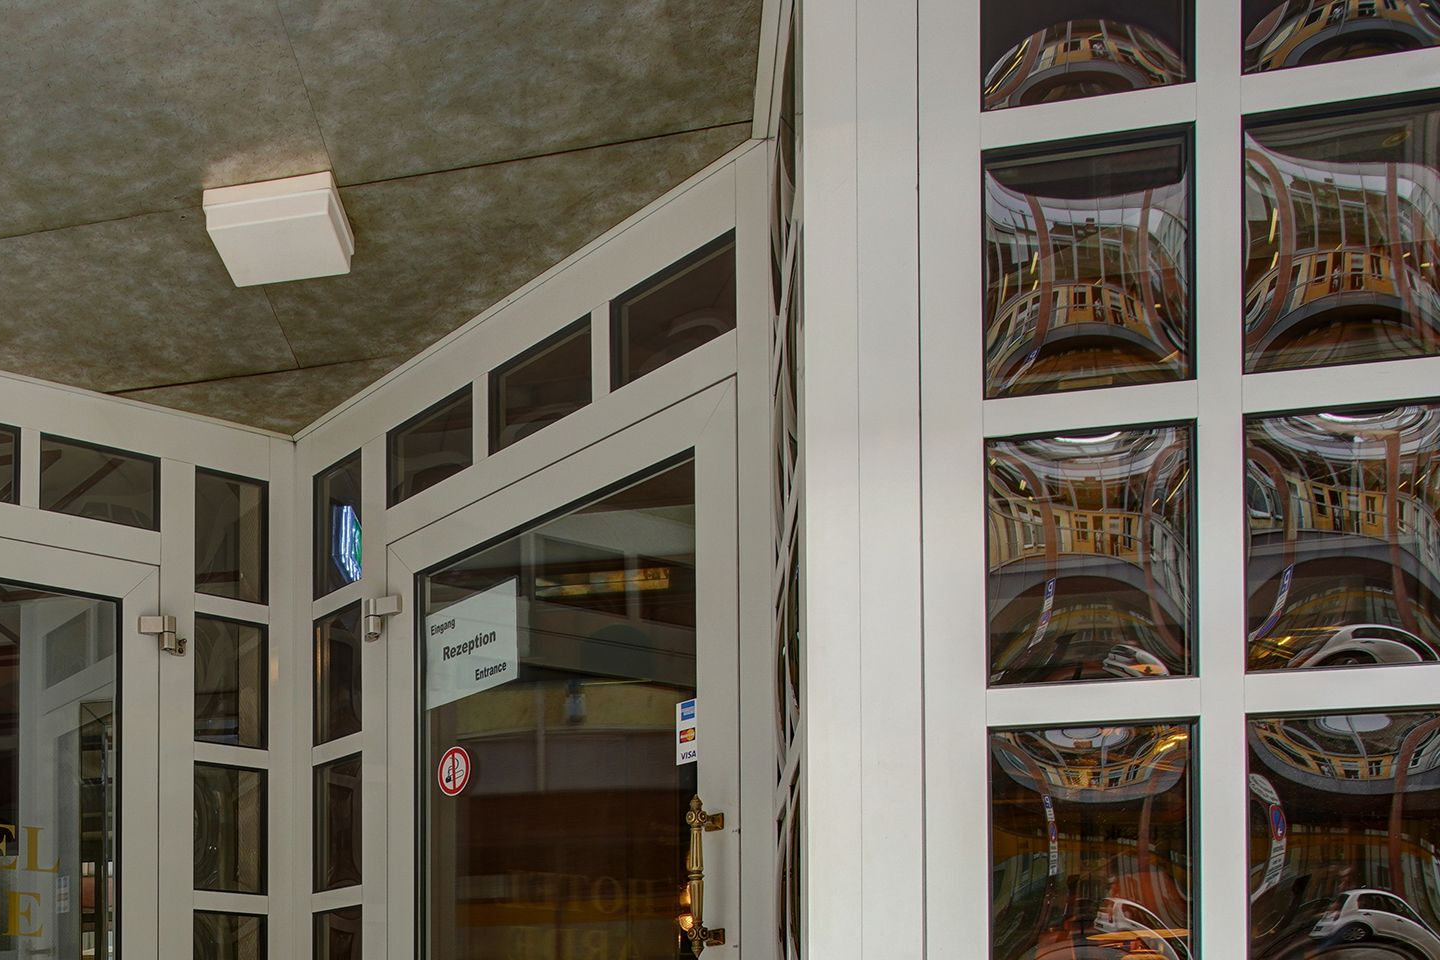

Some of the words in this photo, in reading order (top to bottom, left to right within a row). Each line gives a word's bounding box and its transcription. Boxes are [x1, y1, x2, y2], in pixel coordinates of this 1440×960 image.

[430, 618, 456, 636] Eingang
[442, 630, 497, 661] Rezeption
[475, 661, 507, 681] Entrance
[680, 750, 697, 760] VISA
